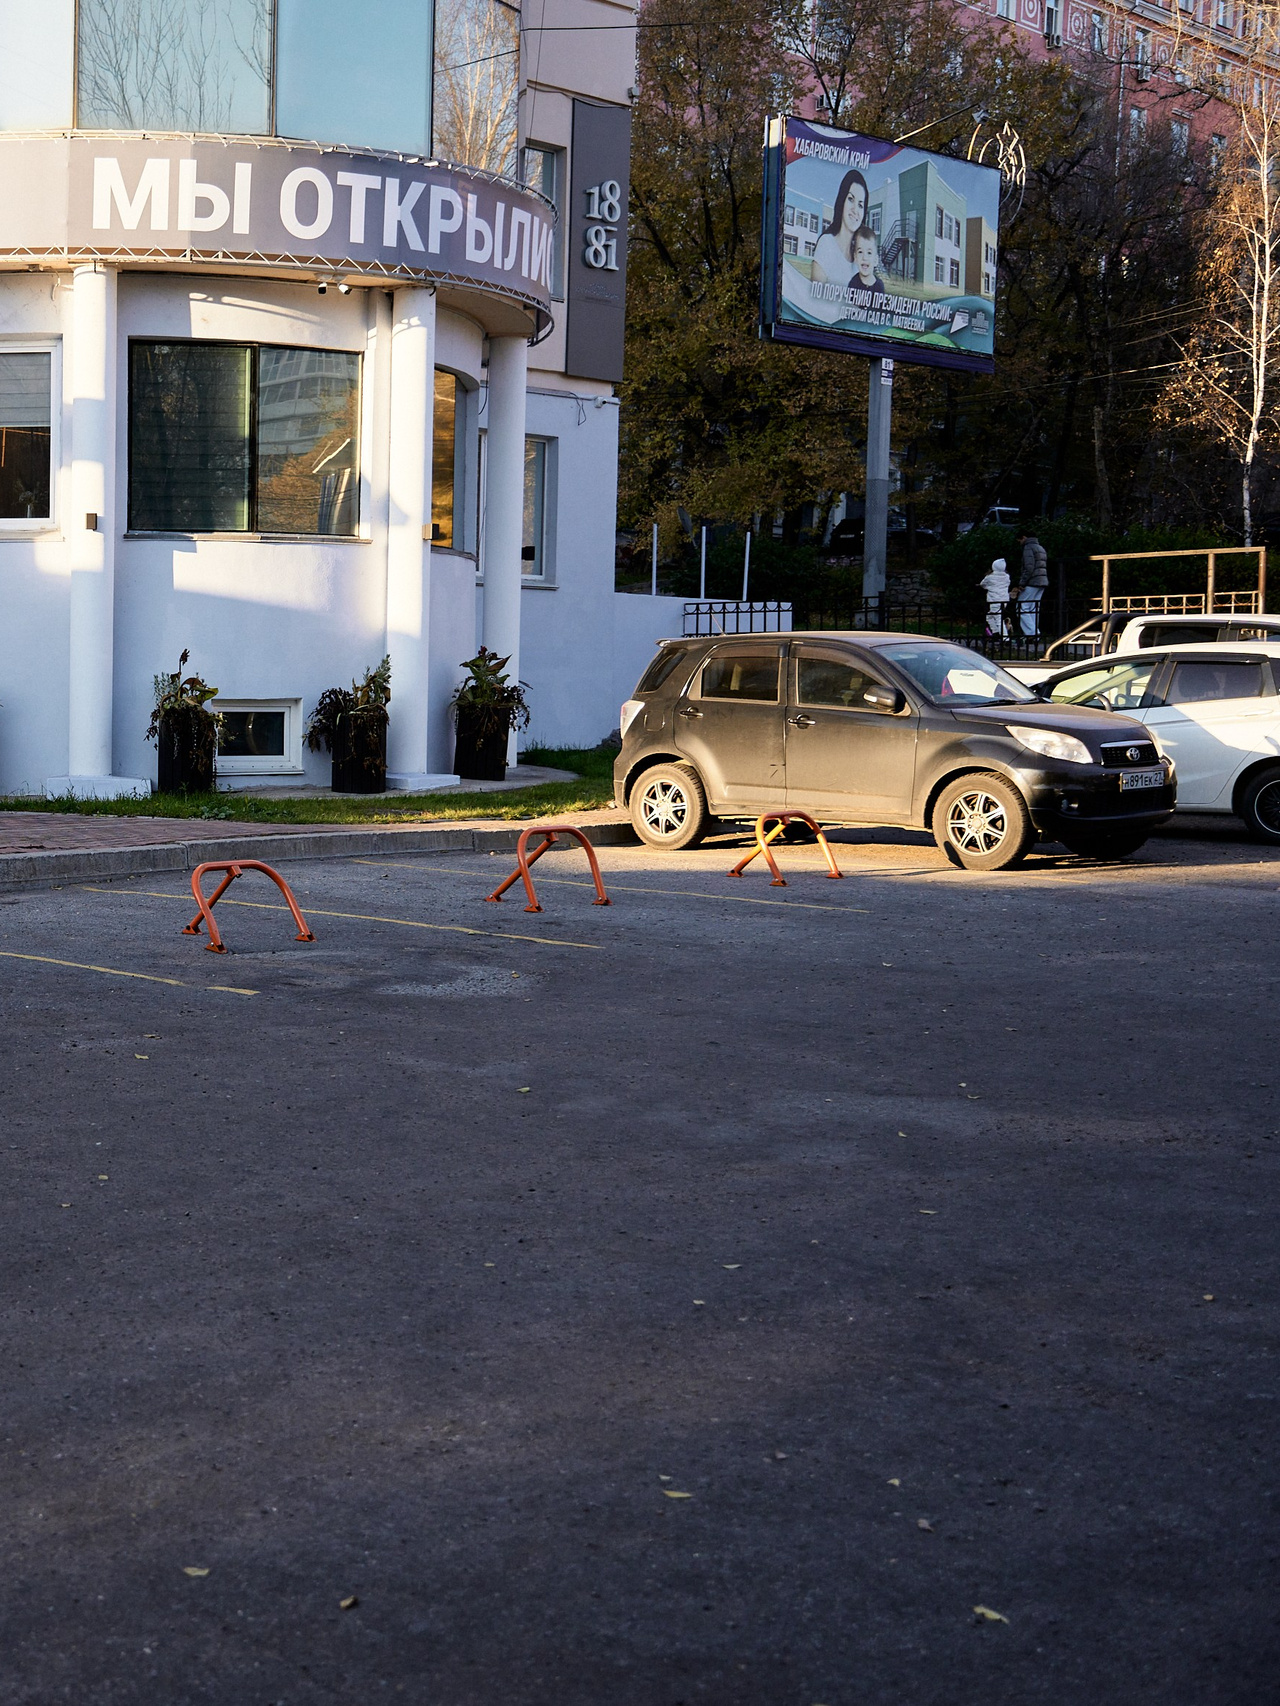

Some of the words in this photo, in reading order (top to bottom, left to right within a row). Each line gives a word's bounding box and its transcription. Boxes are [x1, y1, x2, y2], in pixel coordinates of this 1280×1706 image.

[793, 137, 850, 165] ХАБАРОВСКИЙ
[849, 150, 871, 170] КРАЙ
[92, 157, 252, 235] МЫ
[585, 180, 621, 223] 18
[585, 225, 619, 271] 81
[810, 281, 821, 299] ПО
[822, 283, 873, 308] ПОРУЧЕНИЮ
[872, 291, 921, 316] ПРЕЗИДЕНТА
[921, 301, 953, 322] РОССИИ:
[839, 306, 867, 323] ДЕТСКИЙ
[866, 311, 880, 327] САД
[880, 313, 886, 325] В
[892, 315, 925, 333] МАТВЕЕВКА
